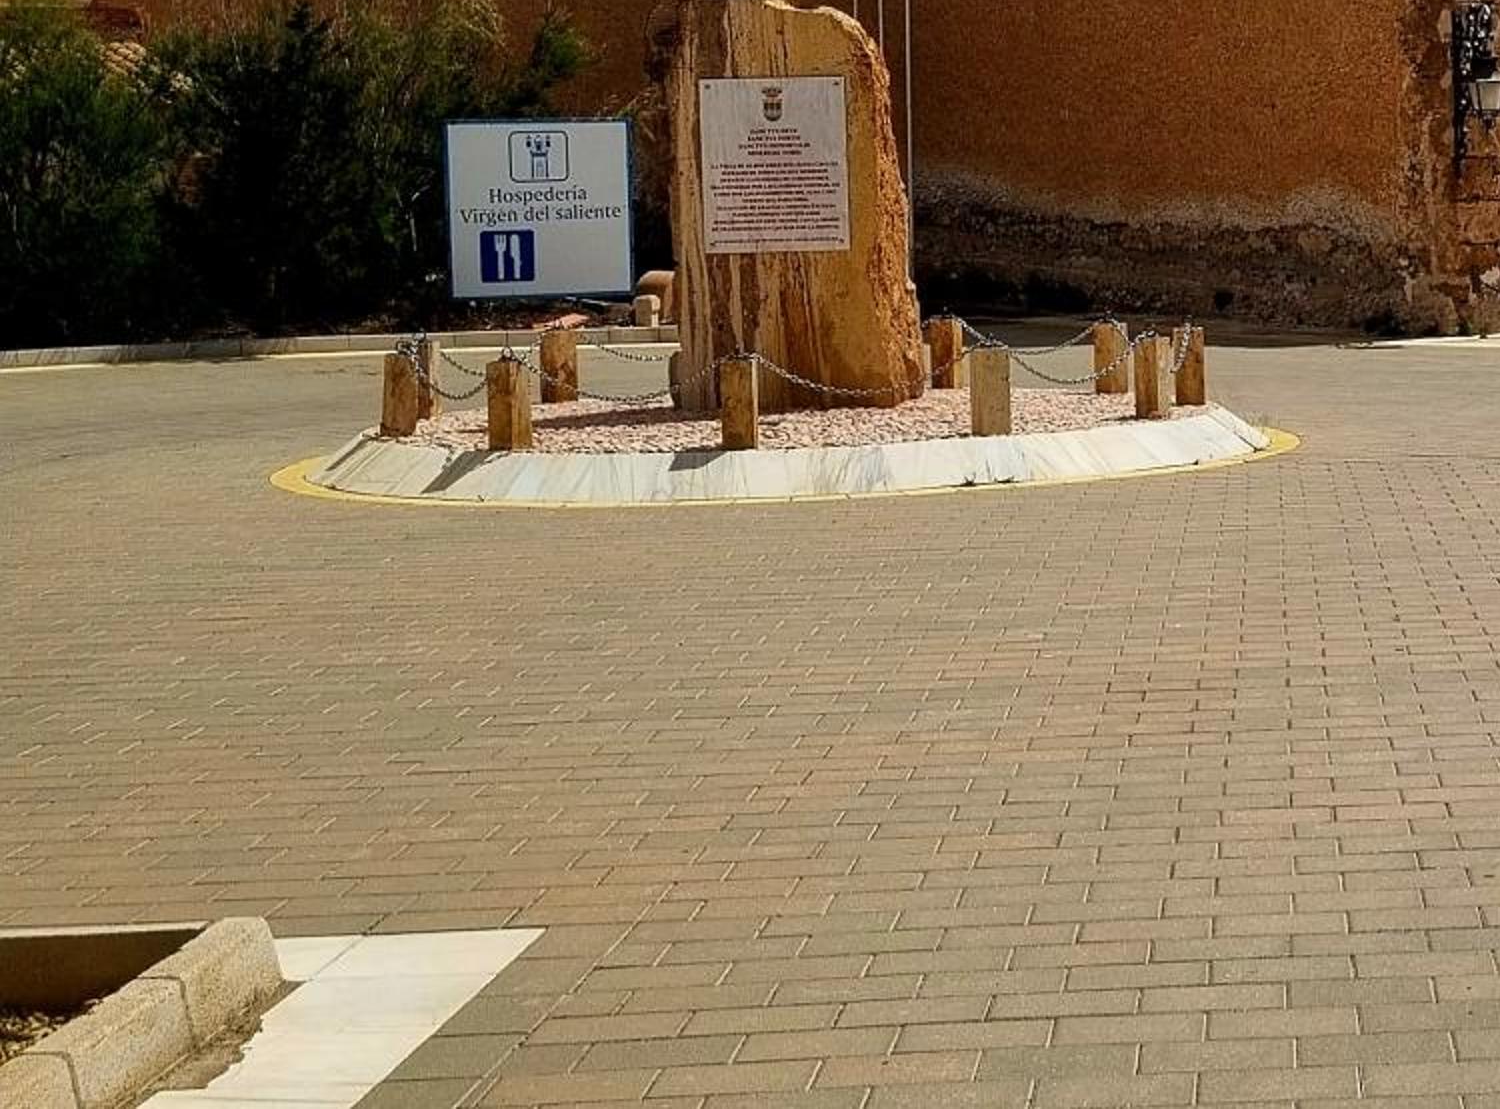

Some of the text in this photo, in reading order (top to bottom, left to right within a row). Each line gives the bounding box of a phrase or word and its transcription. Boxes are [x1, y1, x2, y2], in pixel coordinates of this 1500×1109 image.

[460, 204, 622, 227] Virgen del saliente
